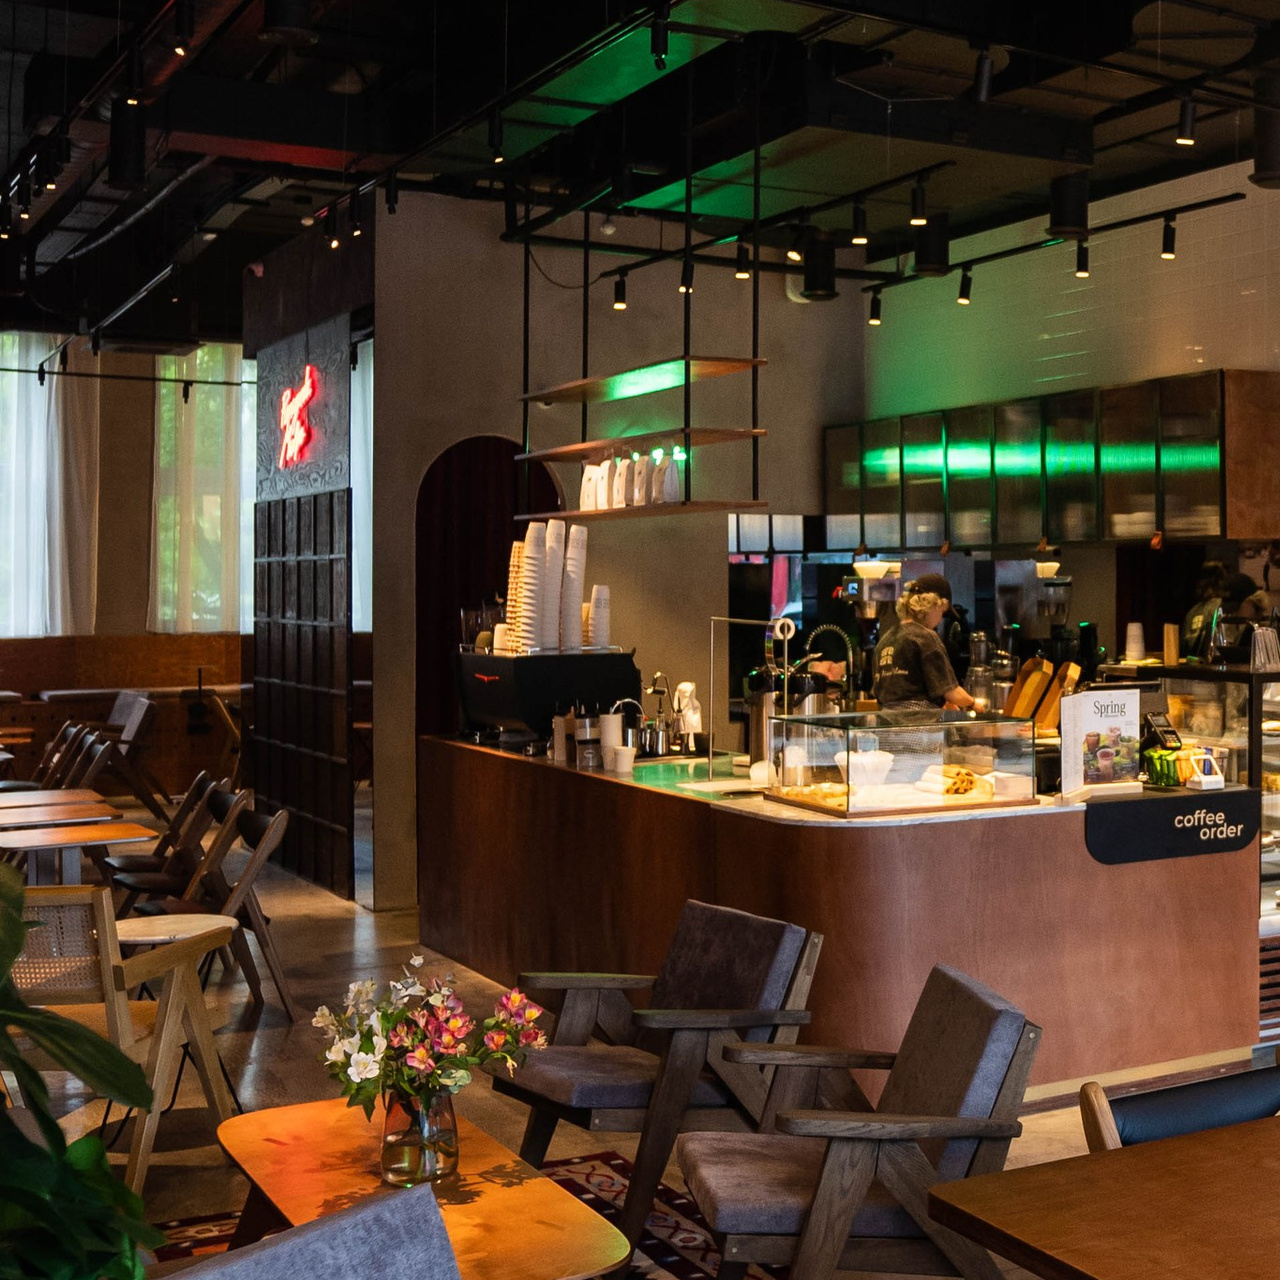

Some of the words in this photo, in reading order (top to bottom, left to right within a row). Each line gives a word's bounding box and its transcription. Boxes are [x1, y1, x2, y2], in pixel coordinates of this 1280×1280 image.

[1094, 700, 1126, 718] Spring
[1174, 809, 1225, 828] coffee
[1200, 822, 1244, 840] order
